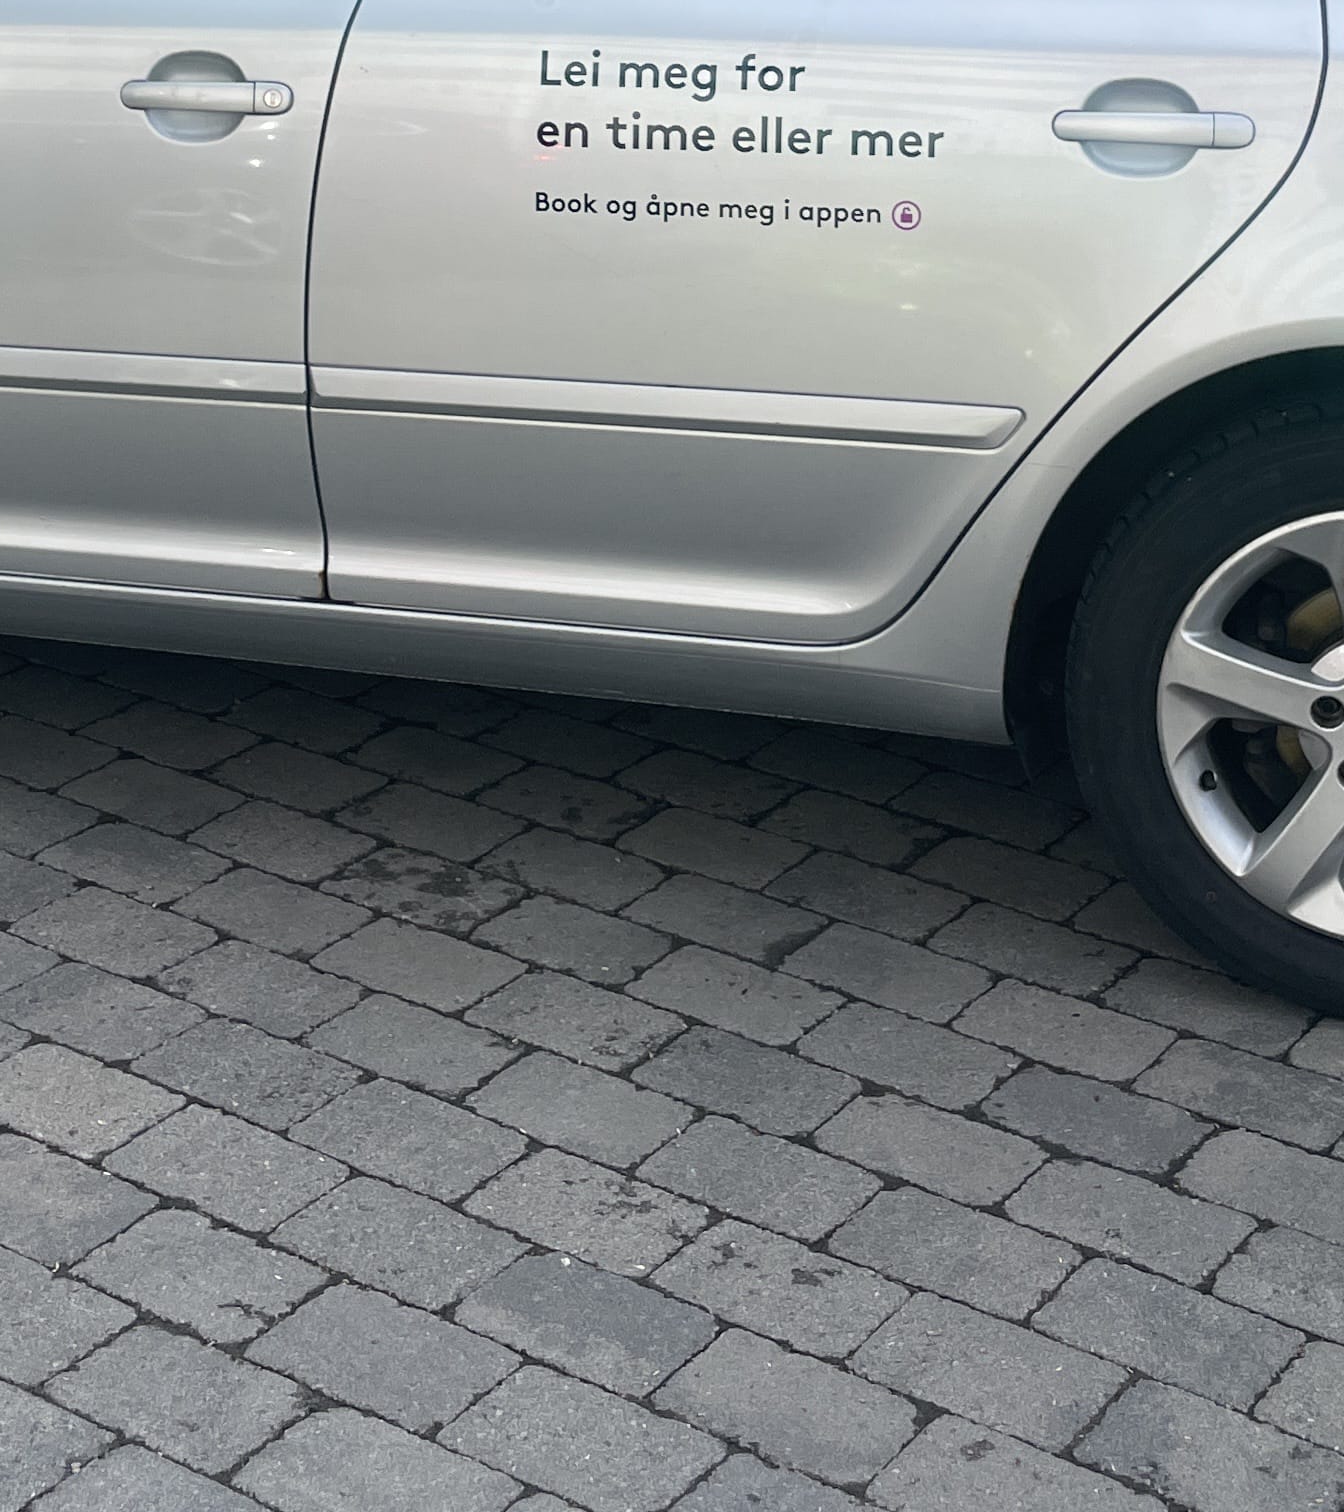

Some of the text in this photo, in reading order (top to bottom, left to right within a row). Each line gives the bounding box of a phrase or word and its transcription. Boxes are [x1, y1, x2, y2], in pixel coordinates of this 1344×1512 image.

[540, 49, 806, 102] Lei meg for
[536, 111, 945, 158] en time eller mer
[535, 191, 881, 229] Book og åpne meg i appen
